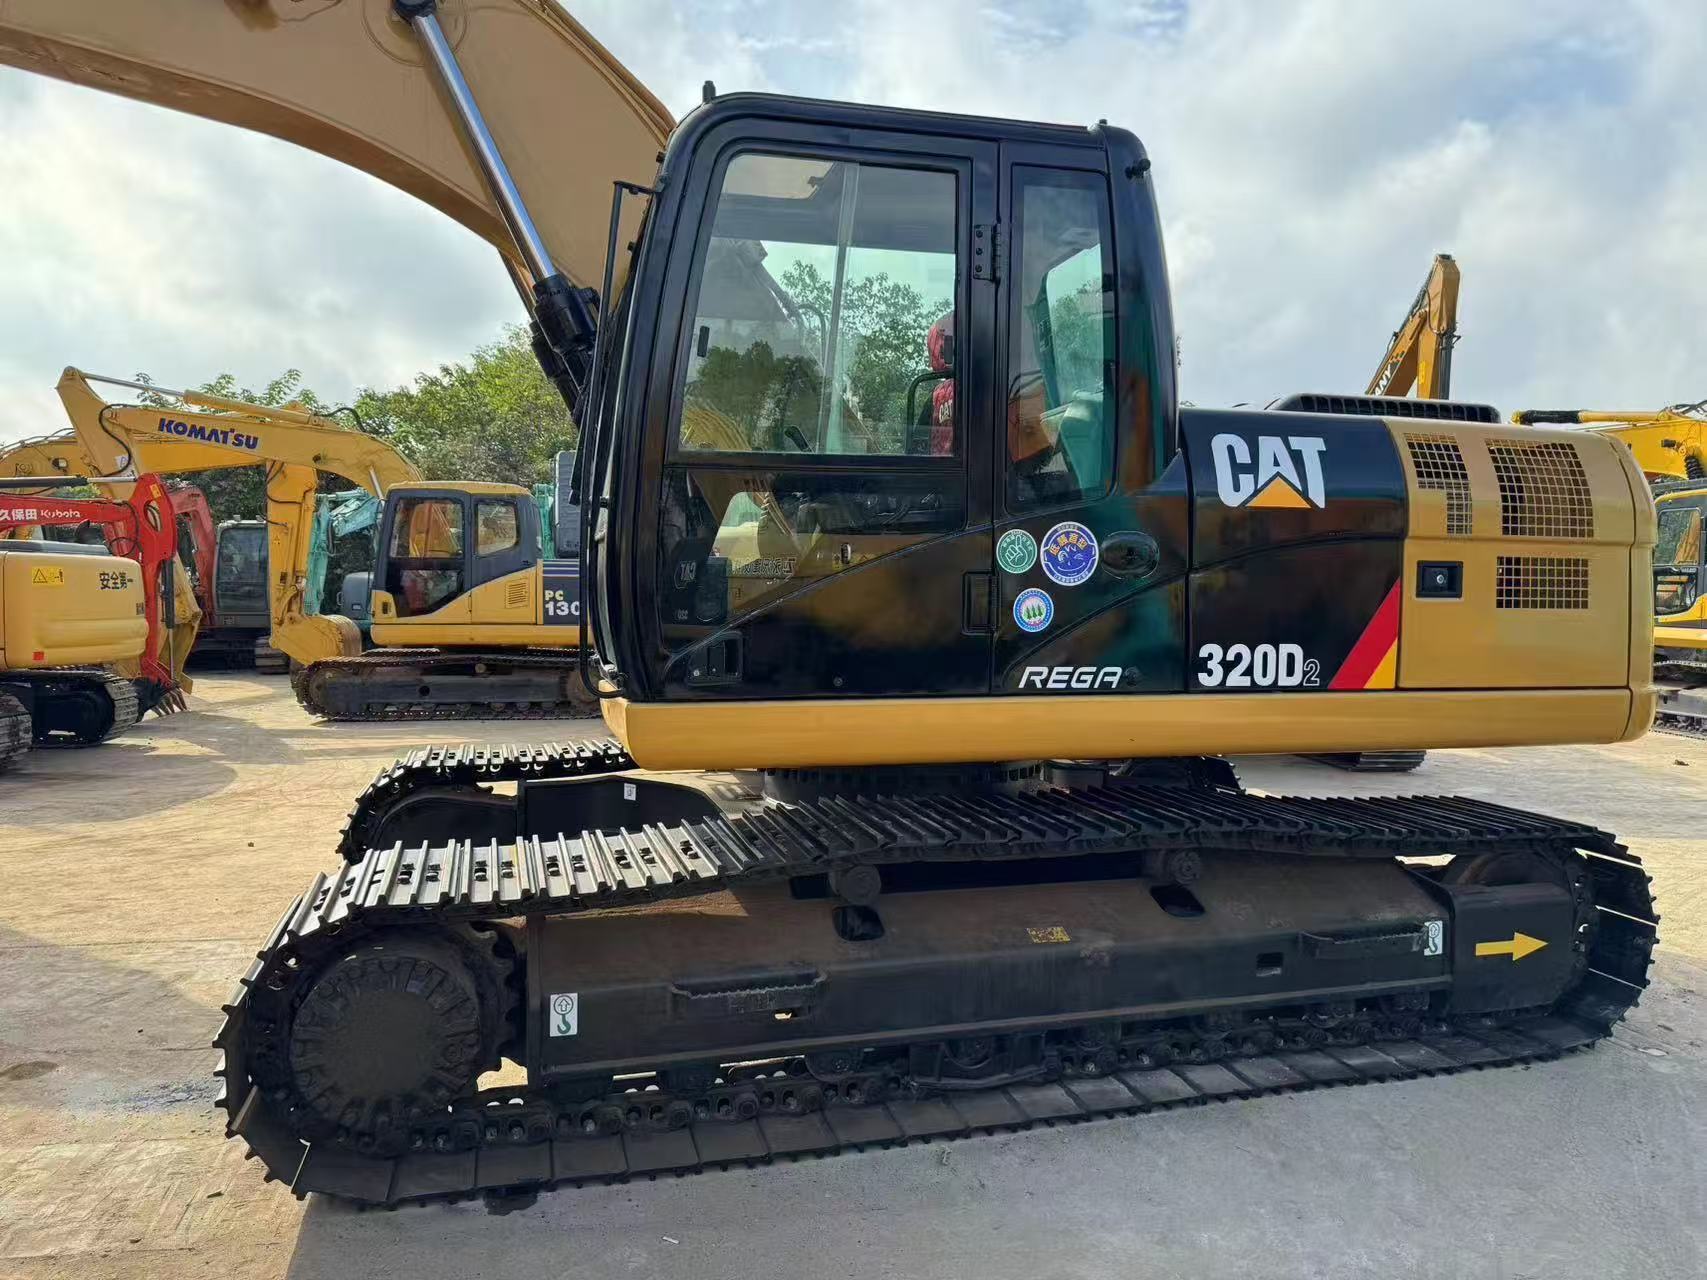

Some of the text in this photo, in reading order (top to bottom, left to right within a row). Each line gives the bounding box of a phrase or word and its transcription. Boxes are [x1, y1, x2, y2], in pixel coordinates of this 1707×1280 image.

[158, 418, 259, 449] KOMATSU
[1211, 433, 1326, 508] CAT
[0, 508, 81, 520] 久保田 Kubota
[99, 571, 133, 590] 安全第一
[544, 590, 564, 601] PC
[1018, 666, 1123, 689] REGA
